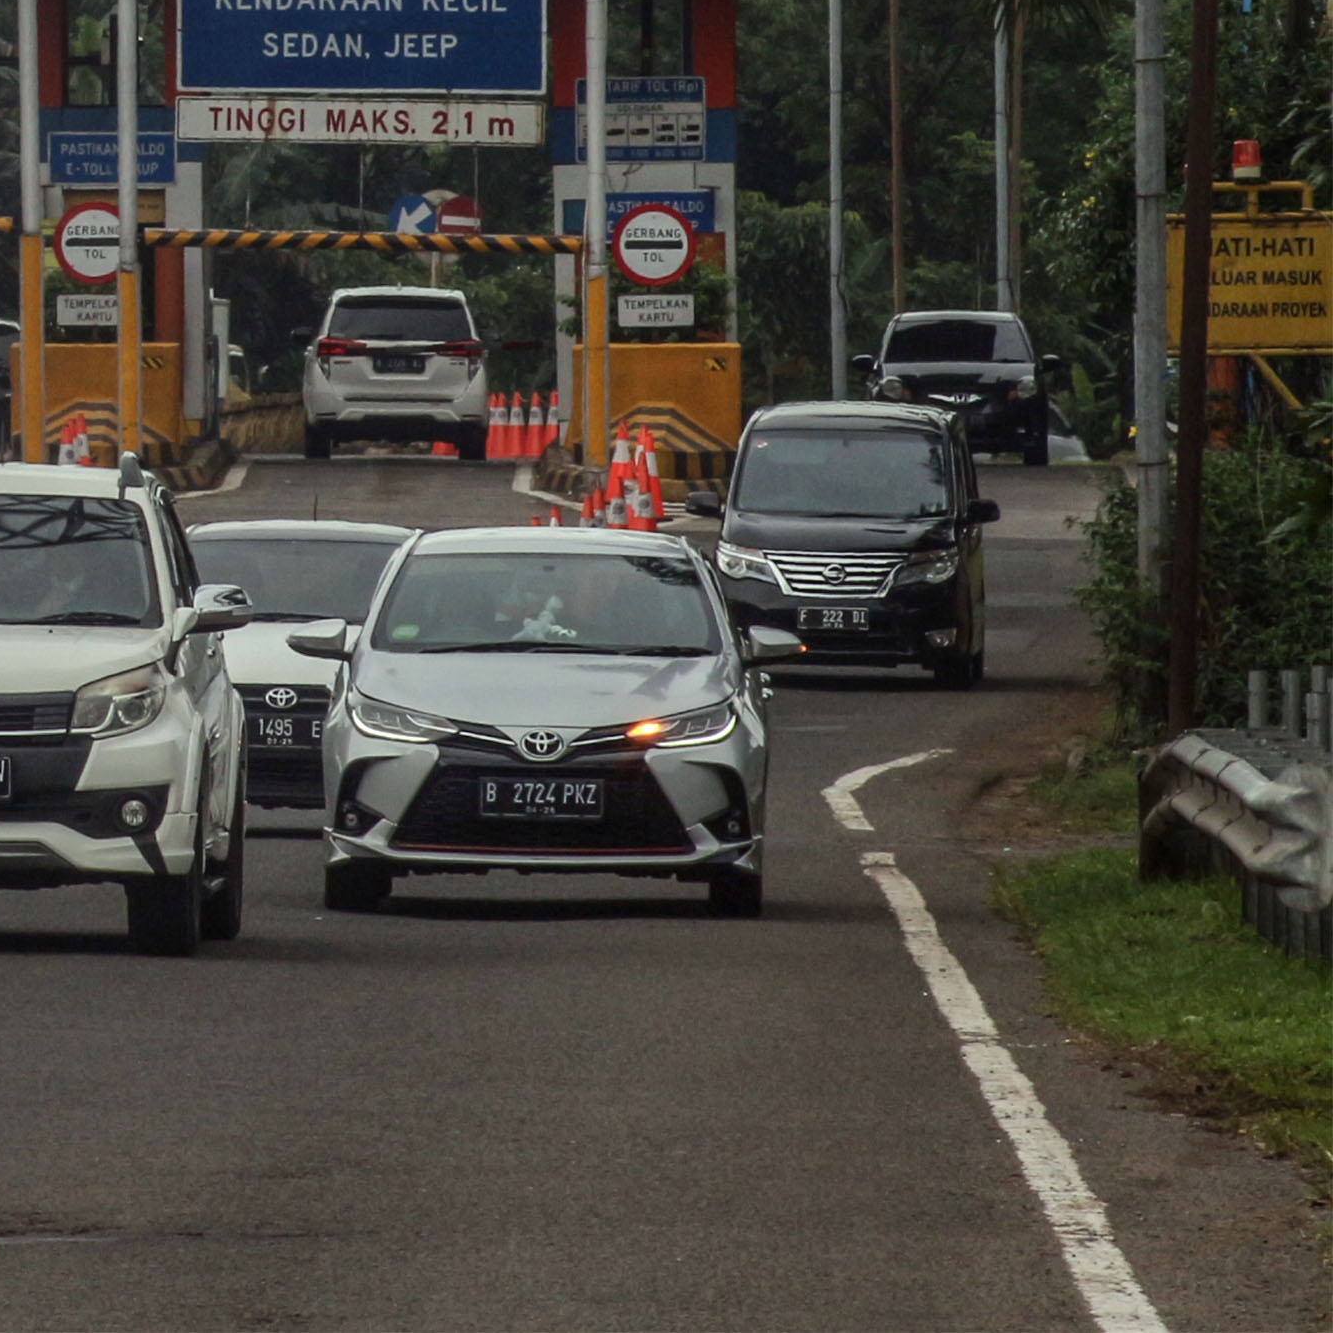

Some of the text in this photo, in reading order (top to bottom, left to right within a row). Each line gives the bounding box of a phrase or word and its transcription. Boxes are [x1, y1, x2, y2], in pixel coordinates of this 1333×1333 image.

[262, 33, 458, 59] SEDAN, JEEP
[646, 80, 670, 92] TOL
[209, 106, 306, 133] TINGGI
[326, 109, 416, 135] MAKS.
[488, 117, 514, 136] m
[132, 143, 166, 156] ALDO
[66, 226, 120, 236] GERBAN
[625, 227, 682, 239] GERBANG
[1210, 237, 1315, 257] ATI-HATI
[85, 249, 106, 260] TOL
[643, 252, 665, 263] TOL
[1209, 269, 1323, 286] LUAR MASUK
[64, 298, 118, 310] TEMPELKA
[624, 299, 689, 310] TEMPELKAN
[1208, 301, 1328, 318] DARAAN PROYEK
[76, 311, 113, 322] KARTU
[638, 311, 675, 323] KARTU
[799, 609, 808, 623] F
[822, 610, 844, 623] 222
[259, 718, 293, 737] 1495
[486, 782, 597, 804] B 2724 PKZ
